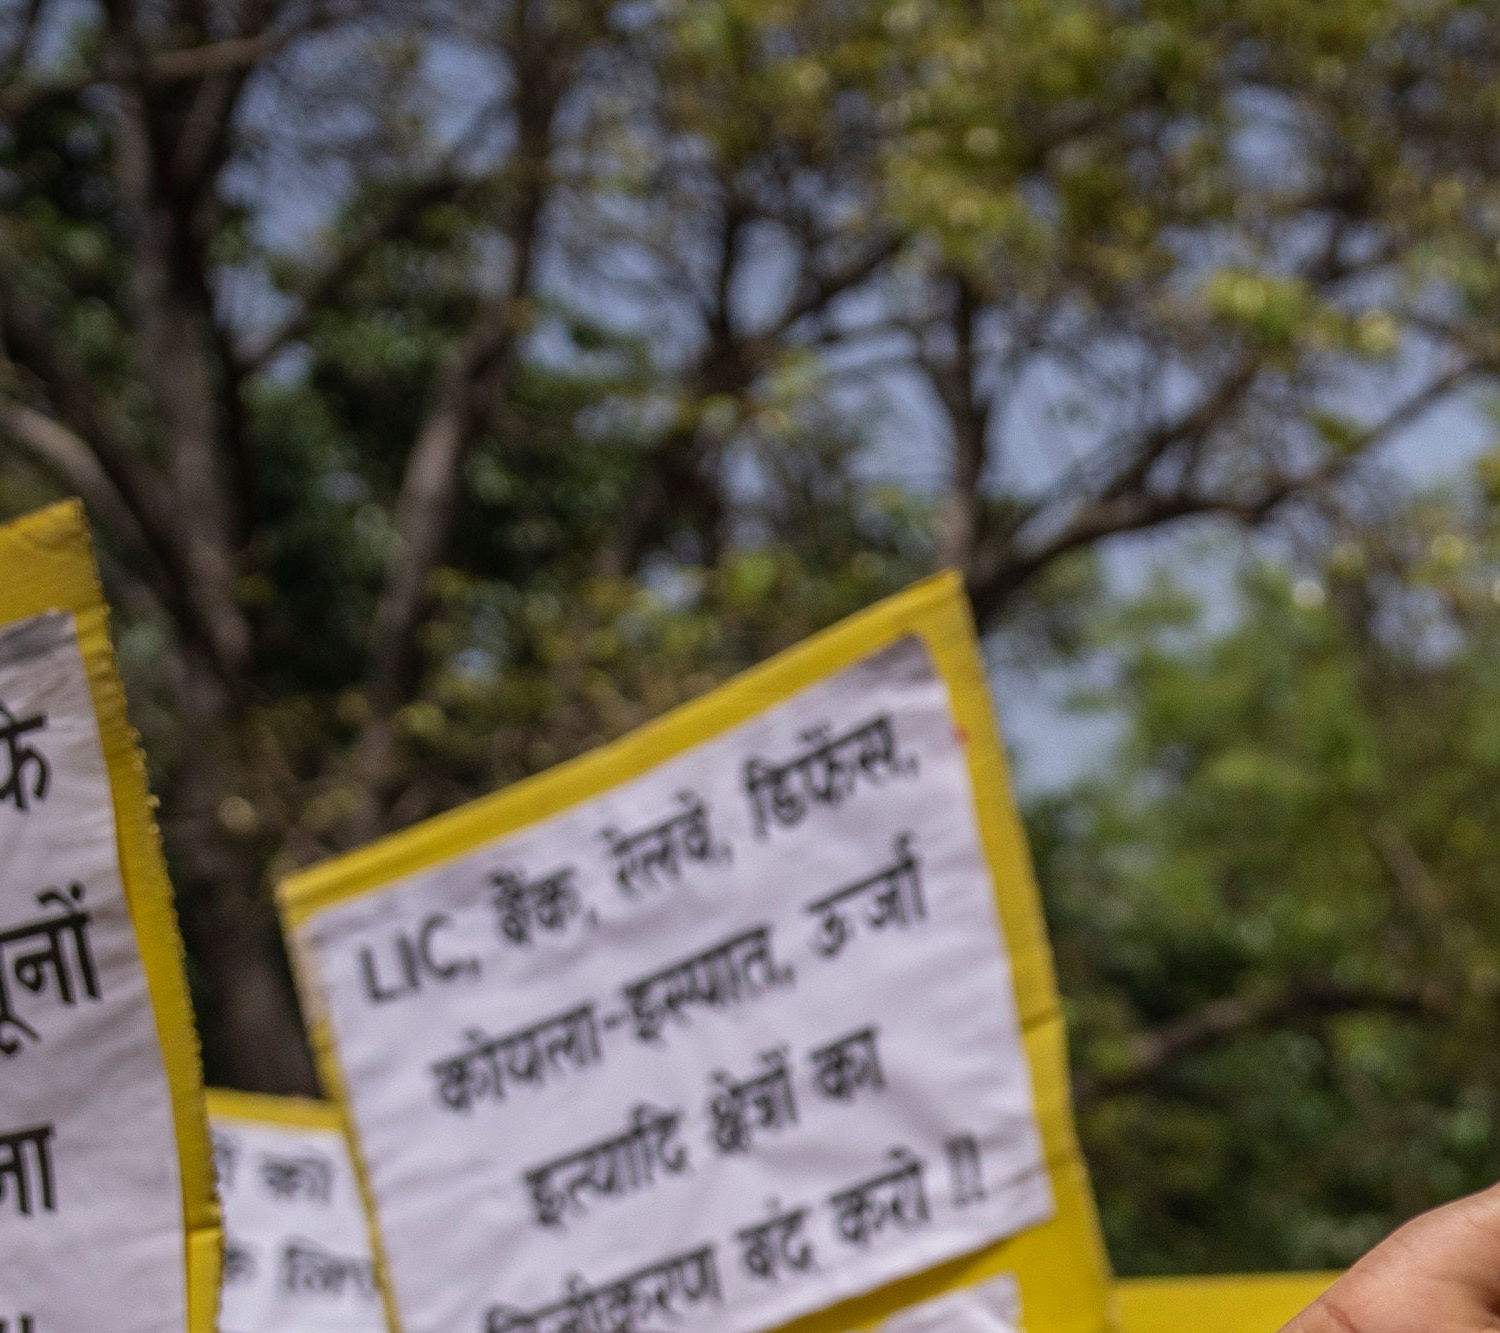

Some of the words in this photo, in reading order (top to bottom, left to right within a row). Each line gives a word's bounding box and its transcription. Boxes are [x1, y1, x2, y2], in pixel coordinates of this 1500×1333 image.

[525, 1102, 690, 1226] इत्यादि
[809, 1025, 886, 1099] का
[738, 1197, 817, 1280] बंद
[827, 1151, 932, 1247] करो
